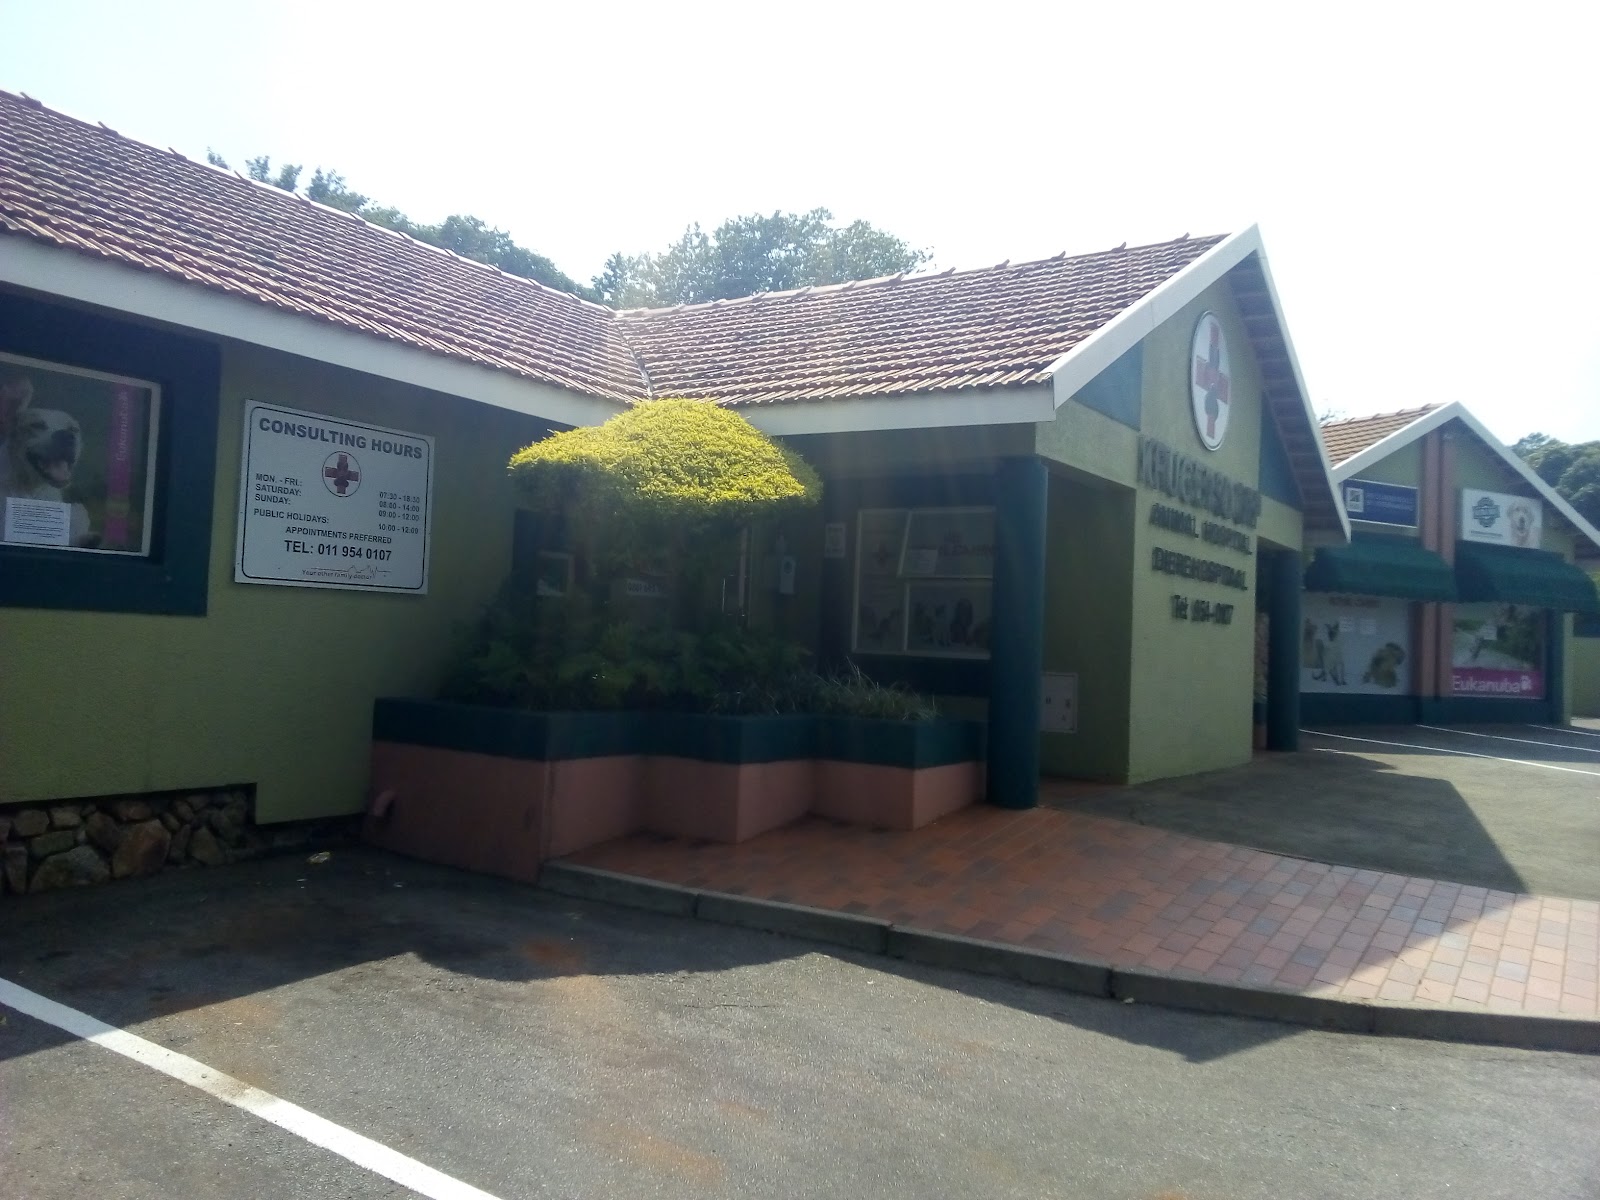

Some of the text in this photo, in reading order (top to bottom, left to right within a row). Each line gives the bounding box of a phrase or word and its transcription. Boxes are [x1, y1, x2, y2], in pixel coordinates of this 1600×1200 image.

[259, 417, 423, 459] CONSULTING HOURS
[255, 473, 276, 483] MON.
[254, 493, 291, 505] SUNDAY:
[255, 484, 302, 497] SATURDAY:
[253, 508, 285, 519] PUBLIC
[286, 511, 329, 524] HOLIDAYS:
[285, 526, 392, 544] APPOINTMENTS PREFERRED
[284, 539, 392, 561] TEL: 011 954 0107
[1452, 675, 1520, 693] Eukanuba
